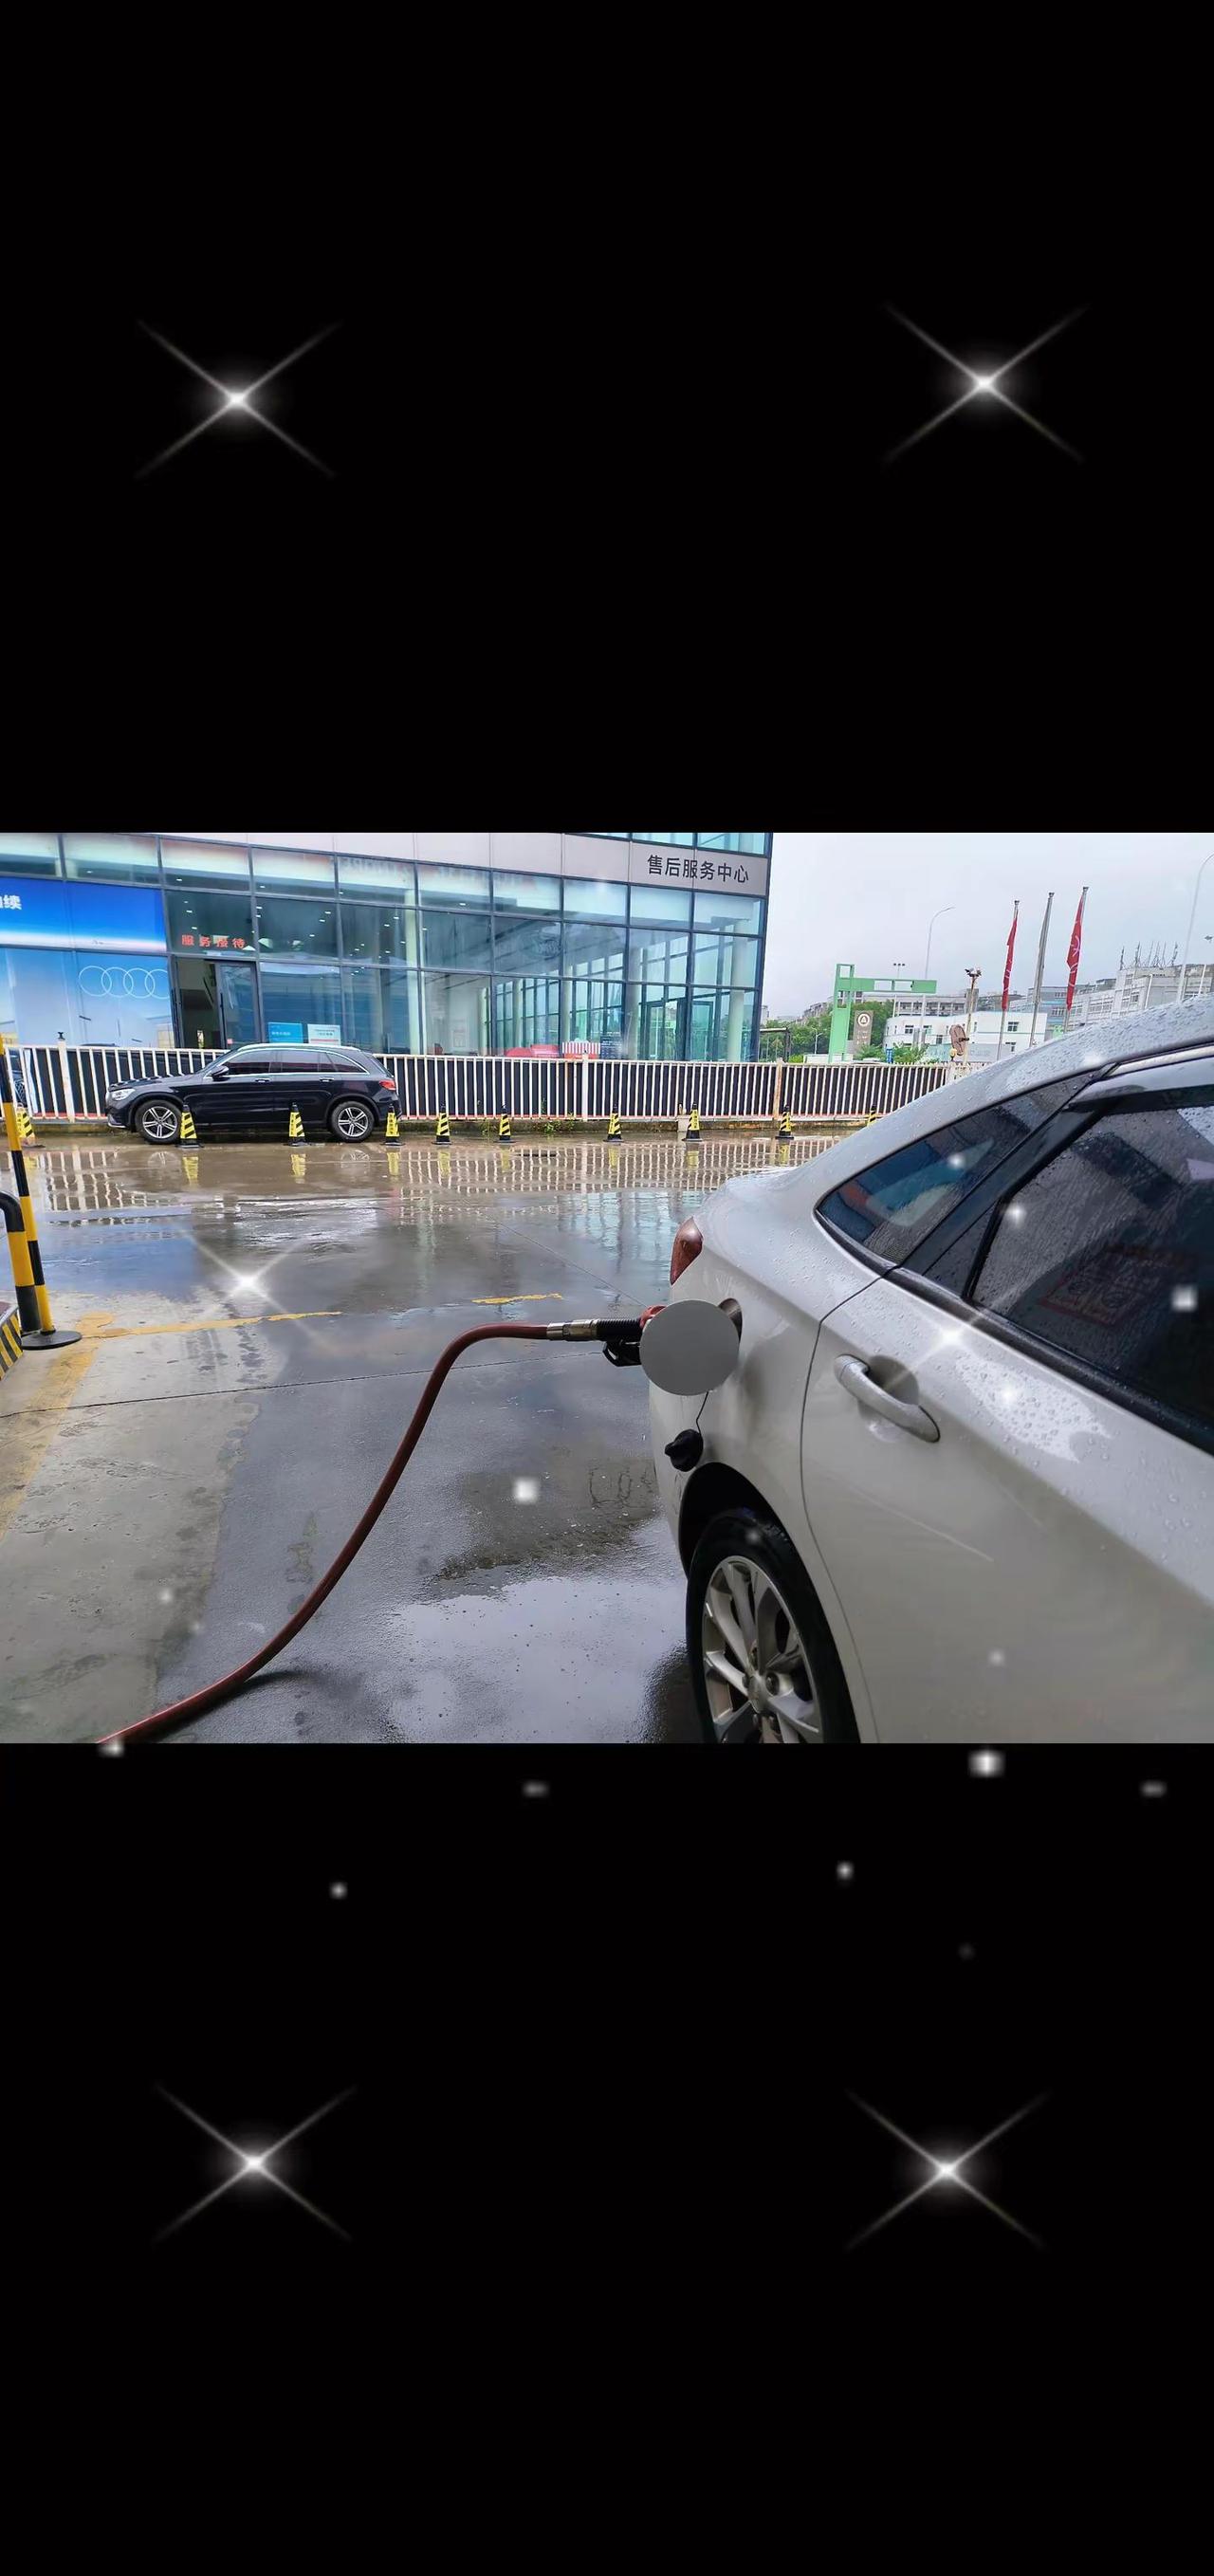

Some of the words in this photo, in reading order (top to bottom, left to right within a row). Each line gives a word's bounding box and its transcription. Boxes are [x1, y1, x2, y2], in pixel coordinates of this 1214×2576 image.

[647, 855, 749, 883] 售后服务中心
[0, 894, 22, 911] 续
